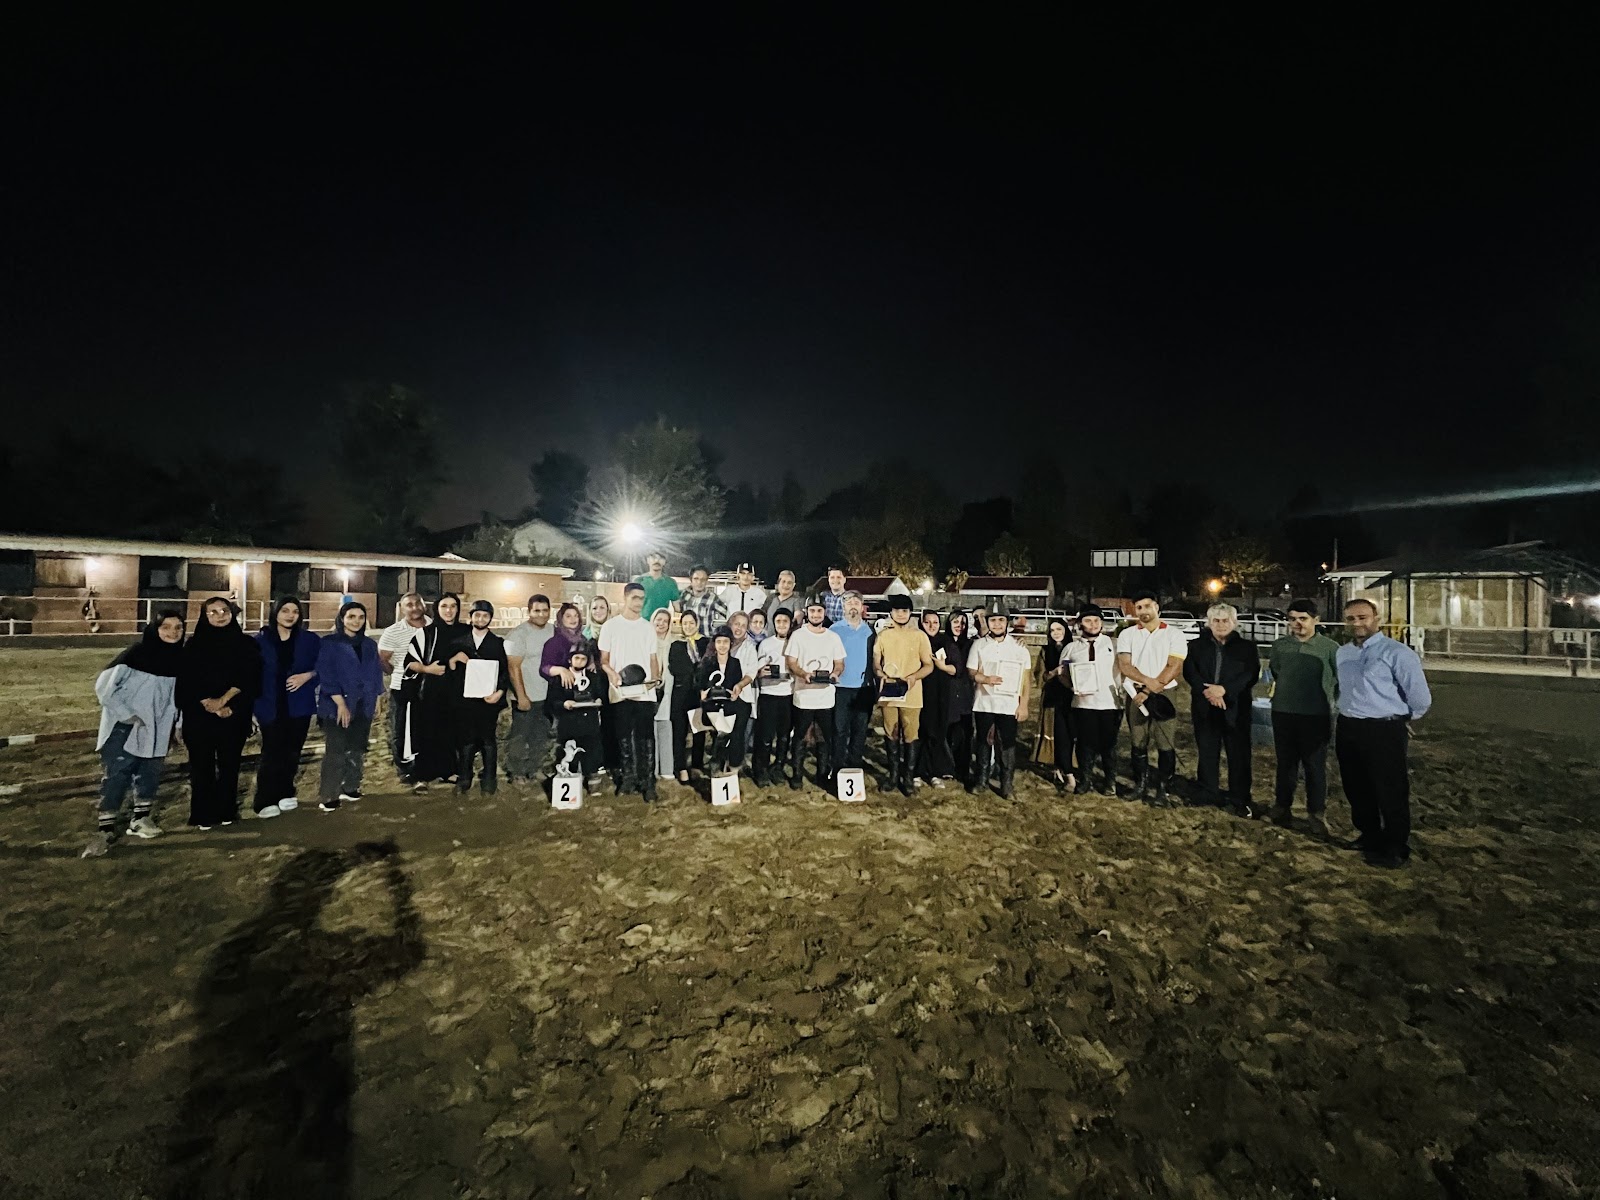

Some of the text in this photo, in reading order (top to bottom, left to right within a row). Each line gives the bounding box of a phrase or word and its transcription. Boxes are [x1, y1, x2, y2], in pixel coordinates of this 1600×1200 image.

[560, 782, 570, 802] 2
[722, 782, 729, 801] 1
[845, 778, 854, 797] 3
